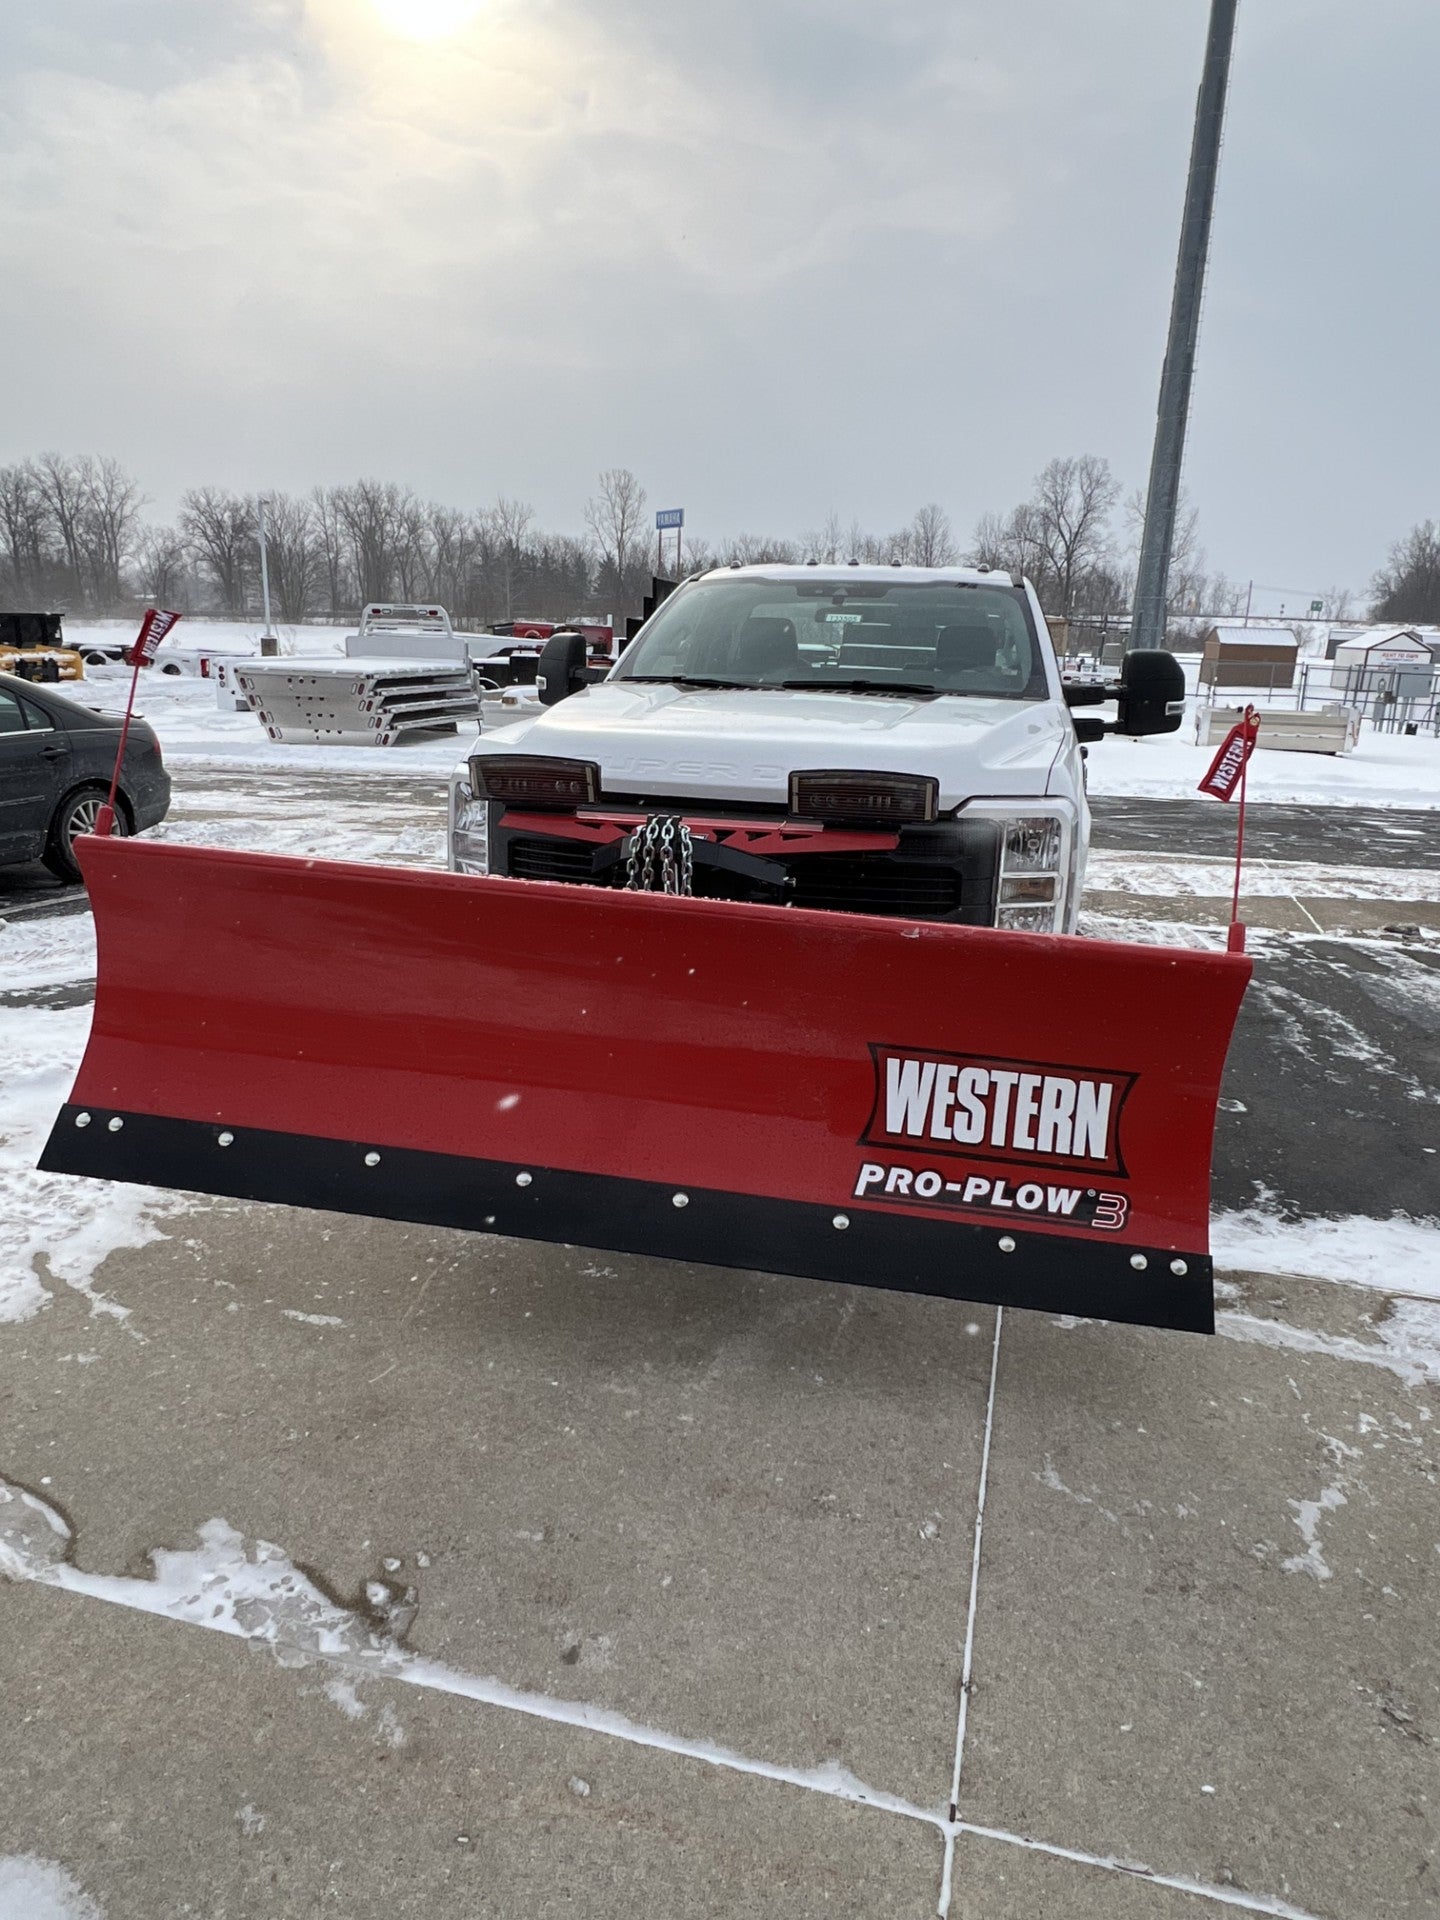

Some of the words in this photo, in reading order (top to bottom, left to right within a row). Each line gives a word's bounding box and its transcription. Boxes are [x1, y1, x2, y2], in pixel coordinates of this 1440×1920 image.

[141, 610, 173, 657] WESTERN
[886, 1057, 1113, 1160] WESTERN
[1091, 1192, 1128, 1230] 3
